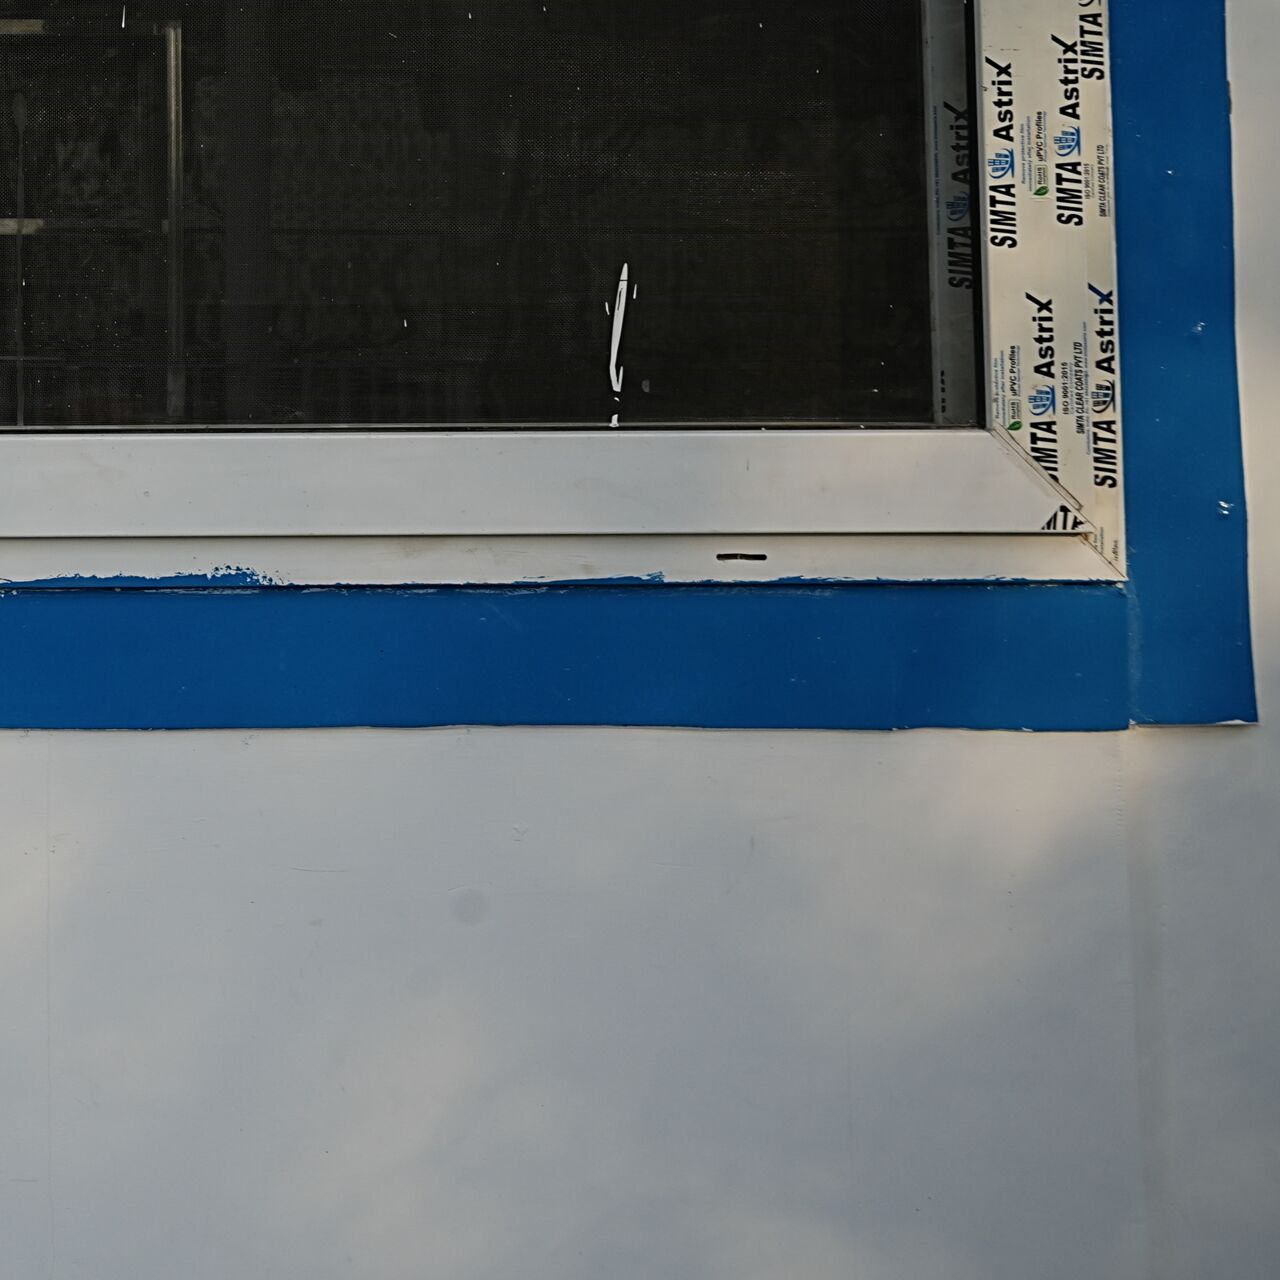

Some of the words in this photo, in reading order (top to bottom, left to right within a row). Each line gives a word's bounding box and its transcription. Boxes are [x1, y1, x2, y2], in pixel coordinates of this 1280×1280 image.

[1079, 13, 1104, 80] SIMTA
[989, 184, 1017, 248] SIMTA
[1055, 162, 1083, 226] SIMTA
[946, 225, 974, 291] SIMTA
[1092, 420, 1117, 488] SIMTA
